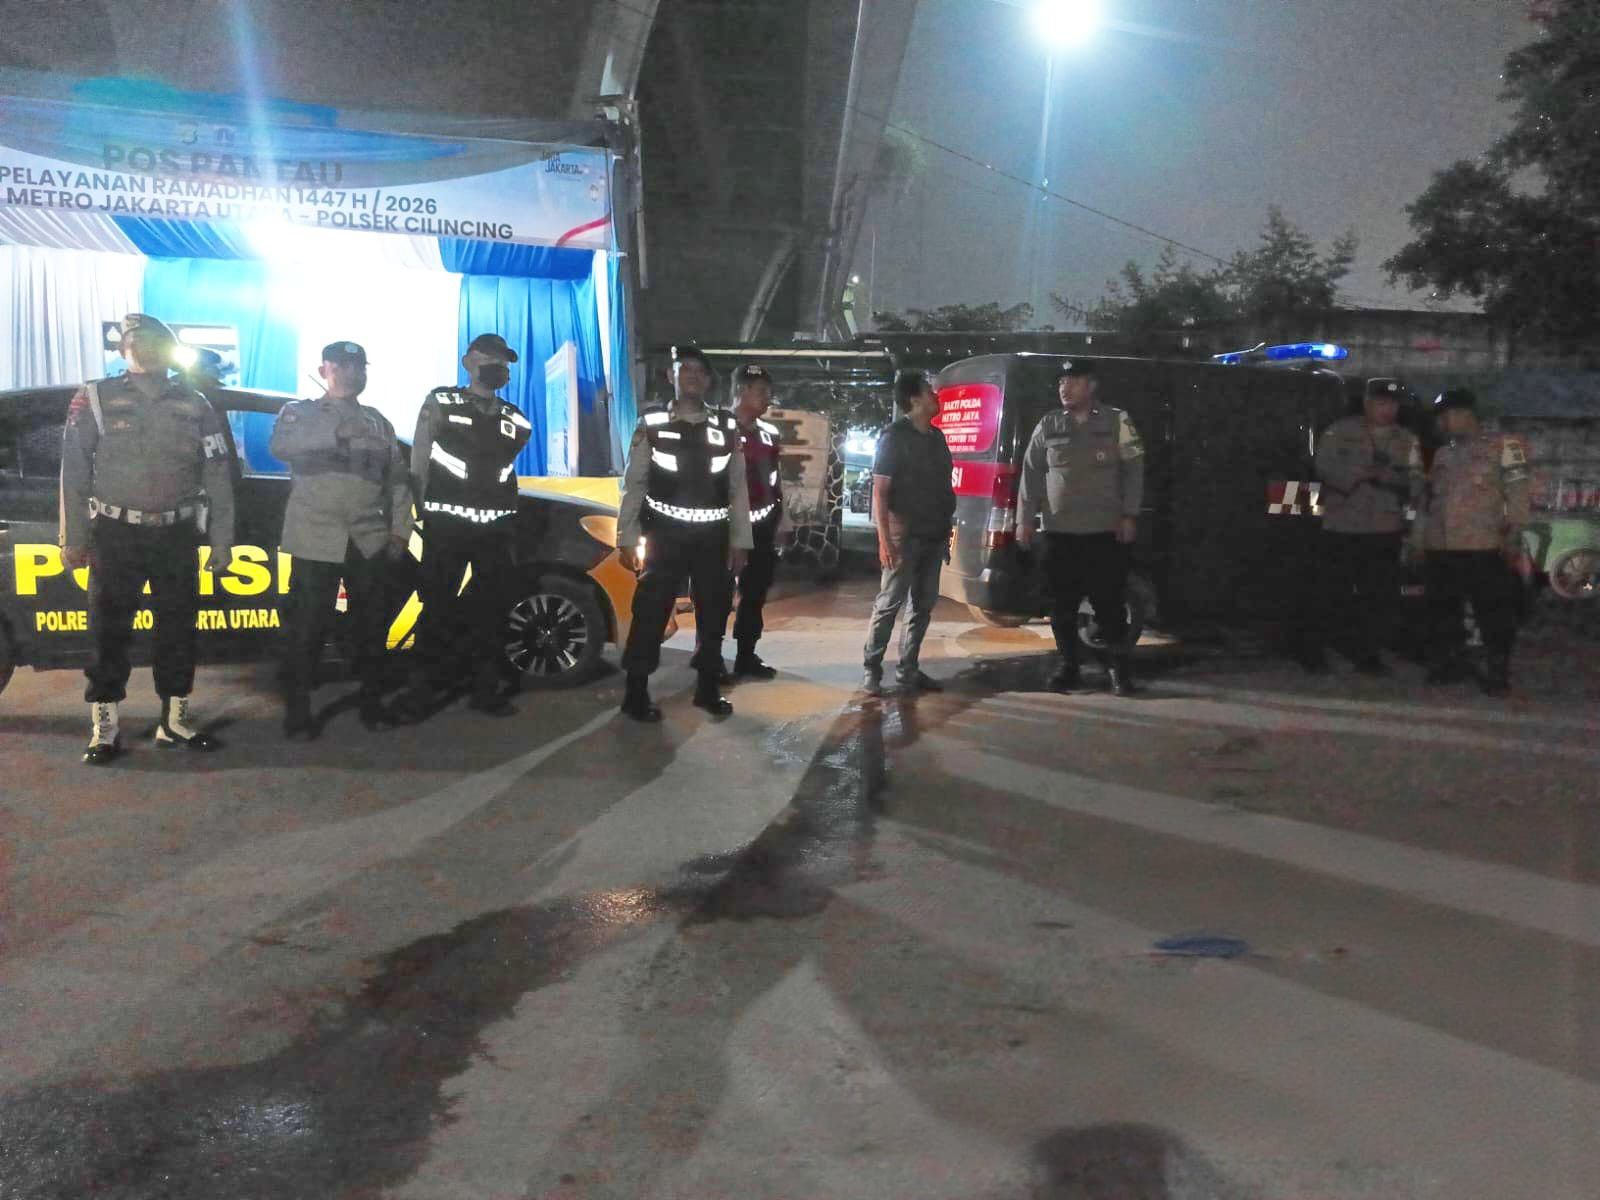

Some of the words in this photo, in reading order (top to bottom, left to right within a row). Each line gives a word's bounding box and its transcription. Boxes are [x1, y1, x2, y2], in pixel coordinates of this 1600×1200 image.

[0, 166, 145, 193] PELAYANAN
[153, 177, 291, 204] RAMADHAN
[298, 187, 346, 208] 1447
[352, 192, 367, 209] H
[385, 195, 438, 215] 2026
[7, 187, 93, 210] METRO
[99, 194, 211, 218] JAKARTA
[317, 210, 399, 231] POLSEK
[404, 217, 513, 239] CILINCING
[14, 543, 293, 595] PISI
[230, 609, 280, 628] UTARA
